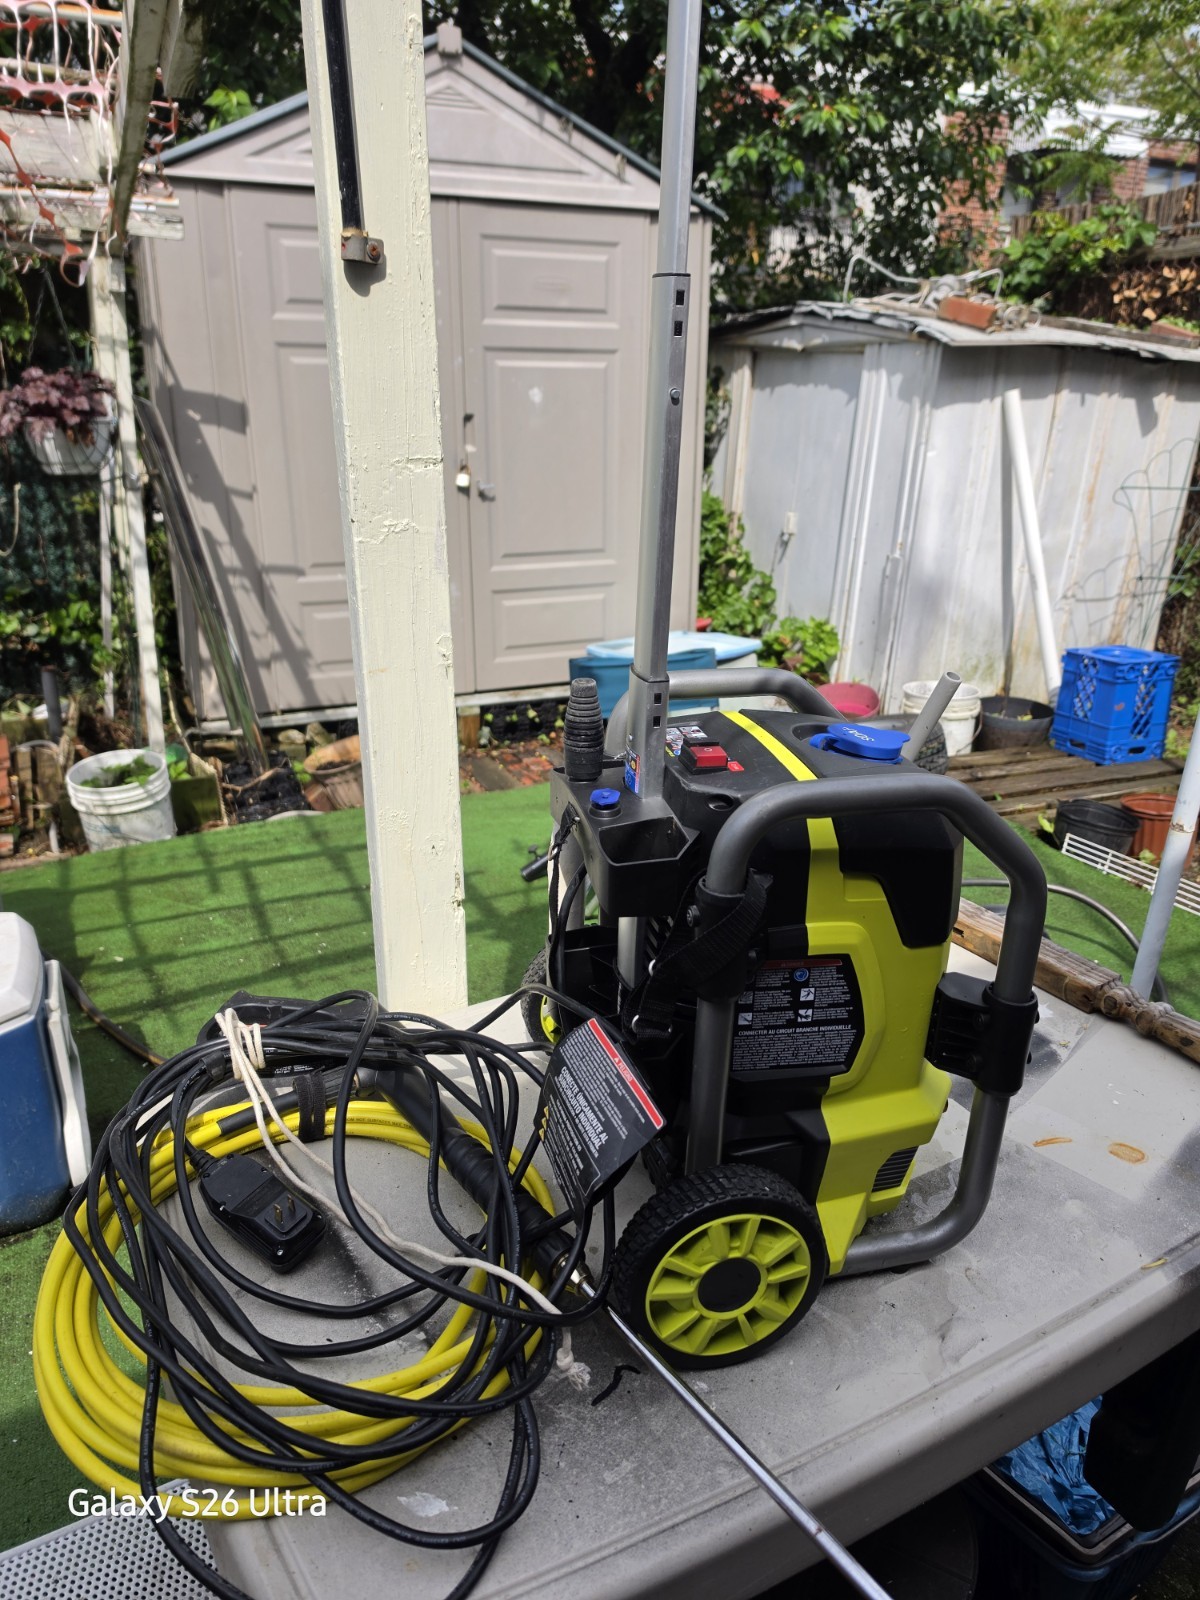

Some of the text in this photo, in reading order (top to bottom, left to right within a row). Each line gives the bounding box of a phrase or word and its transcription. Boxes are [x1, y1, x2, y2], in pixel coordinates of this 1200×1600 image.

[556, 1073, 583, 1114] SUBCIRCUITO
[577, 1111, 603, 1150] INDIVIDUAL
[559, 1065, 580, 1095] CONECTE
[575, 1091, 603, 1134] ÚNICAMENTE
[597, 1131, 610, 1144] AL
